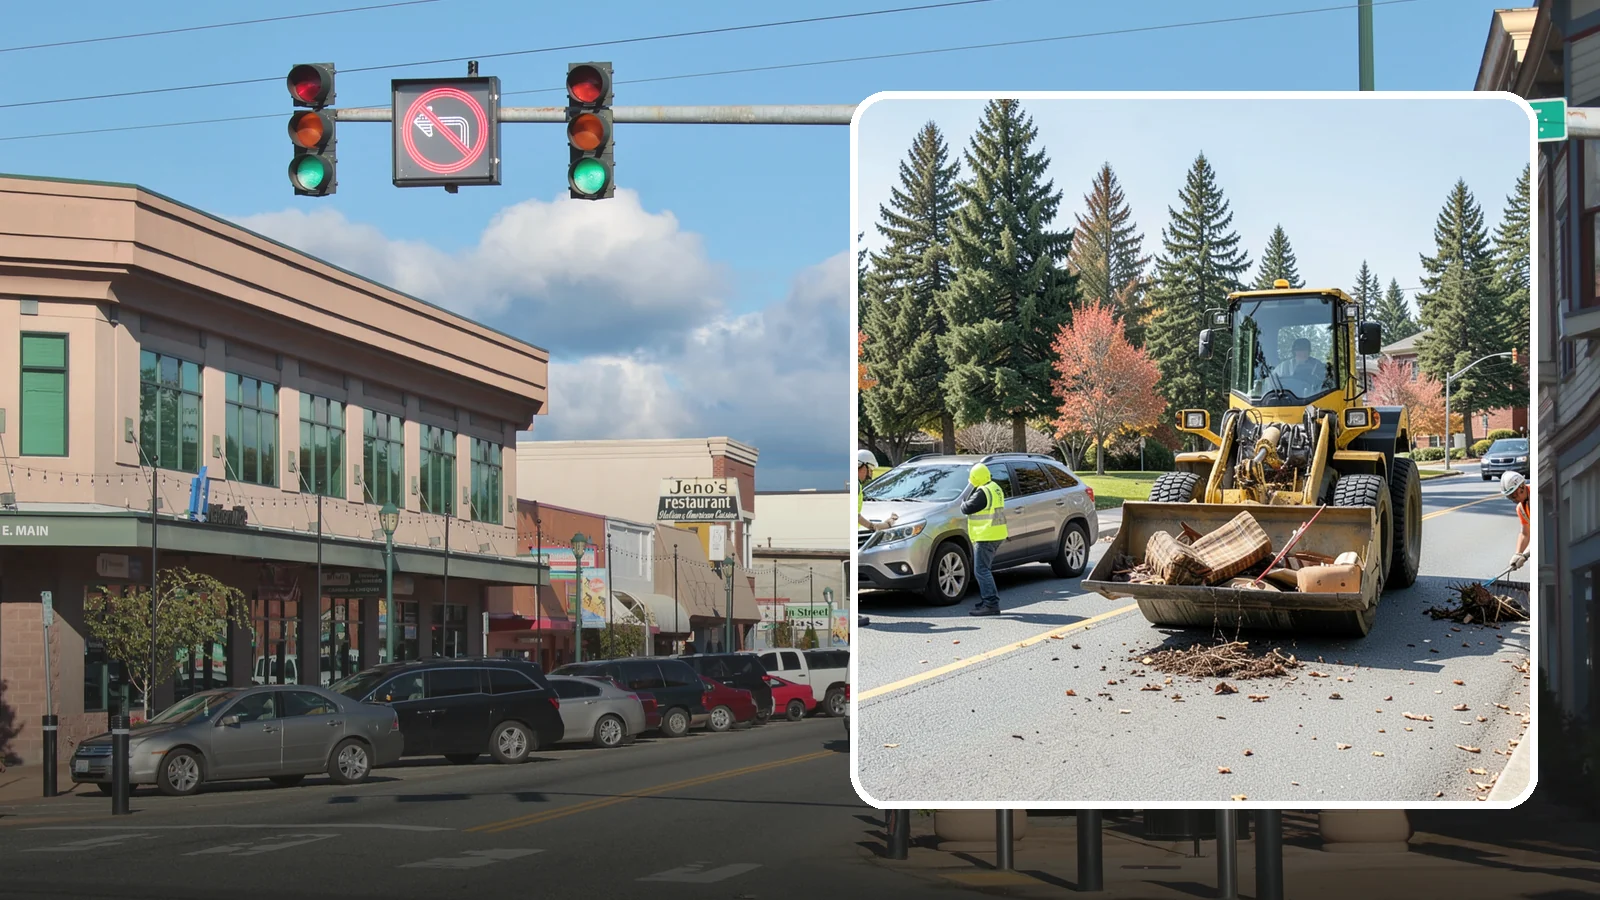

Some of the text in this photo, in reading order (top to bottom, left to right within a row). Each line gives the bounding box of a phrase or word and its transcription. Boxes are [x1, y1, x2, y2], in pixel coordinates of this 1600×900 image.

[669, 480, 727, 494] Jeno's
[665, 496, 731, 509] restaurant
[659, 509, 681, 519] Italian
[686, 509, 715, 519] American
[715, 509, 737, 519] Cuisine
[2, 525, 49, 536] E. MAIN
[797, 608, 828, 616] Street
